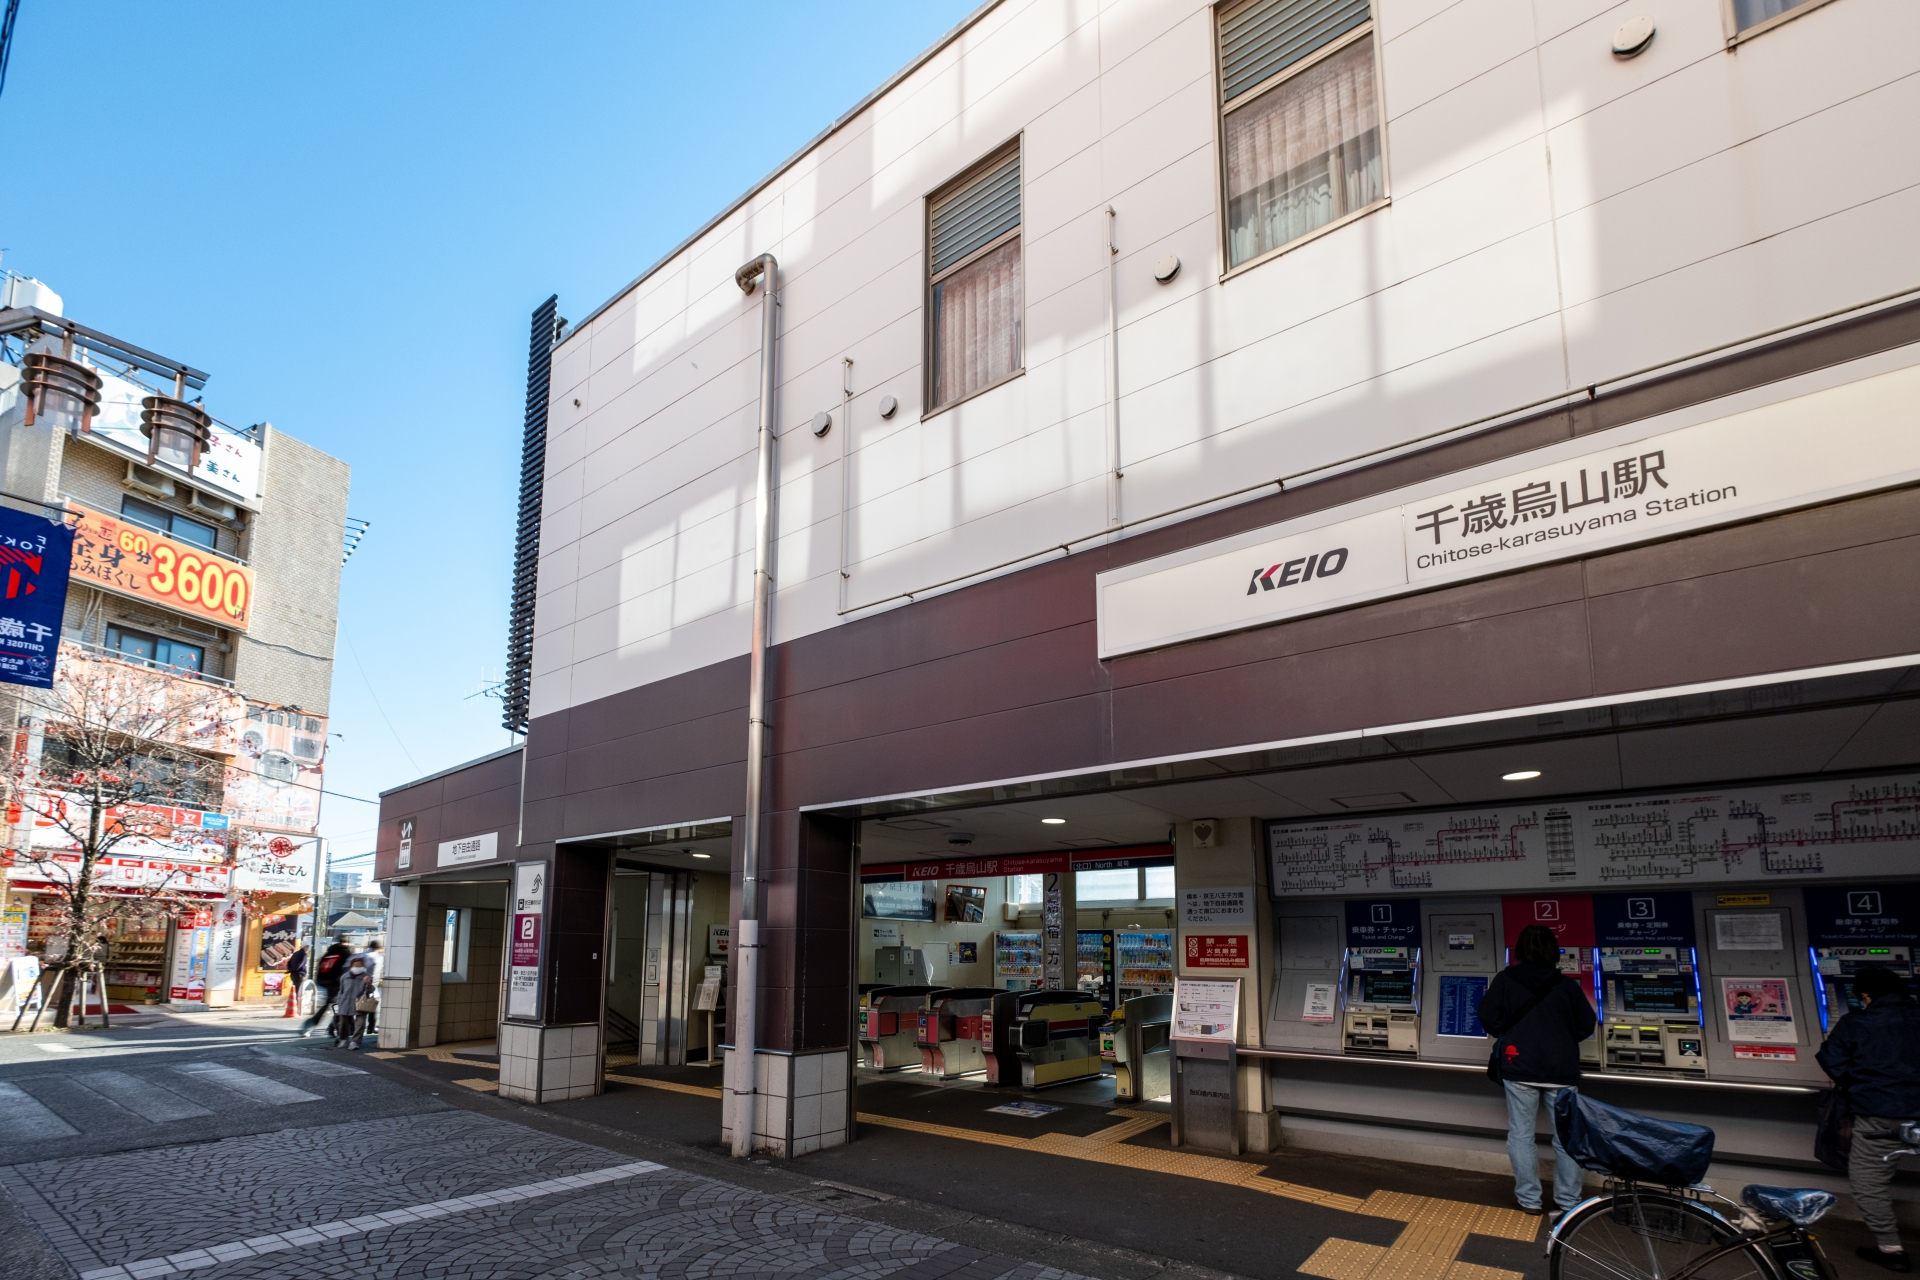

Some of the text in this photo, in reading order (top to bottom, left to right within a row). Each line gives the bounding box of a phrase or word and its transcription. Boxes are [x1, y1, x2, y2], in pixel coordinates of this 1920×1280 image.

[200, 459, 240, 483] 美さん
[1415, 450, 1669, 546] 千歳烏山駅
[1416, 482, 1737, 570] Chitose-karasuyama Station
[73, 533, 126, 567] 全身
[1247, 547, 1348, 596] KEIO
[228, 808, 247, 821] 2F
[452, 839, 481, 855] 地下自由通路
[261, 862, 307, 877] さぼてん
[912, 865, 939, 878] KEIO
[945, 860, 998, 875] 千歳烏山駅
[1095, 861, 1113, 869] North
[1186, 892, 1244, 900] 橋本・京王八王子方面
[1856, 894, 1874, 911] 4
[1541, 903, 1553, 917] 2
[1635, 901, 1648, 916] 3
[524, 919, 533, 938] 2
[1351, 926, 1414, 934] 乗車券・チャージ
